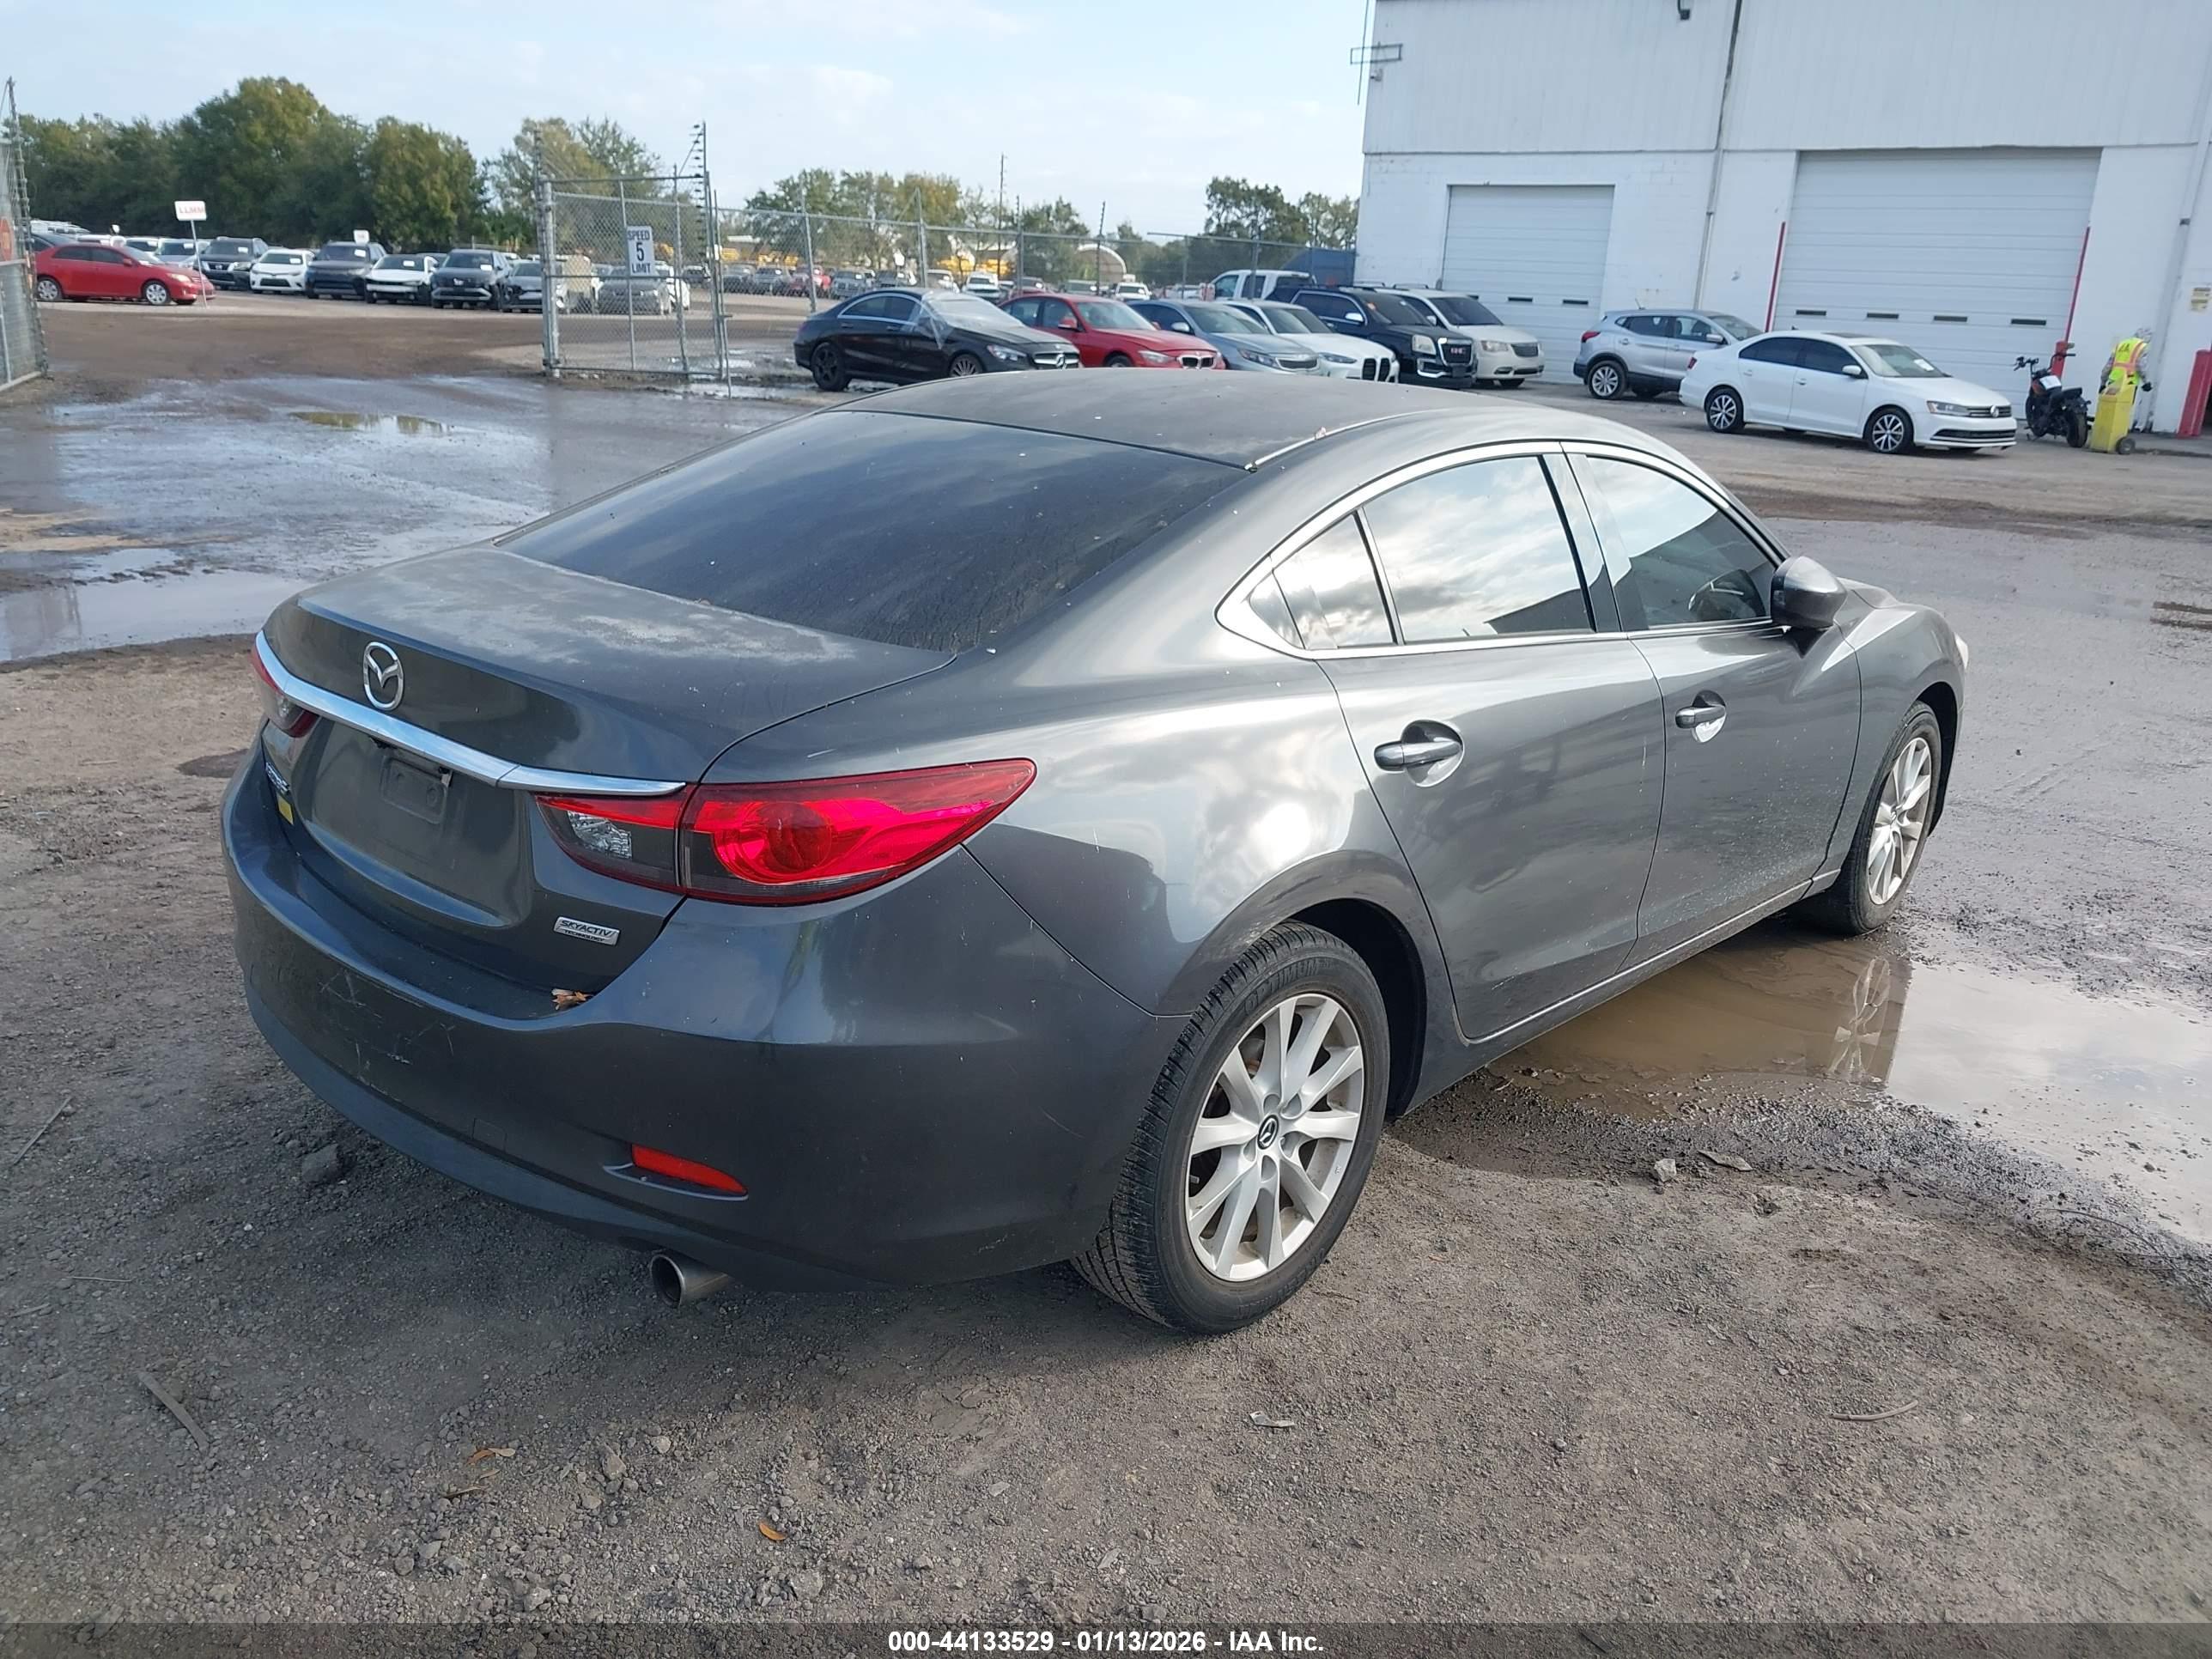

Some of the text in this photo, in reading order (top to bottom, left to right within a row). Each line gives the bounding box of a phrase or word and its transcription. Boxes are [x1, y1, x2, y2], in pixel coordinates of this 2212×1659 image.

[627, 230, 650, 240] SPEED
[635, 241, 645, 262] 5
[631, 263, 651, 274] LIMIT
[559, 920, 612, 936] SKYACTIV
